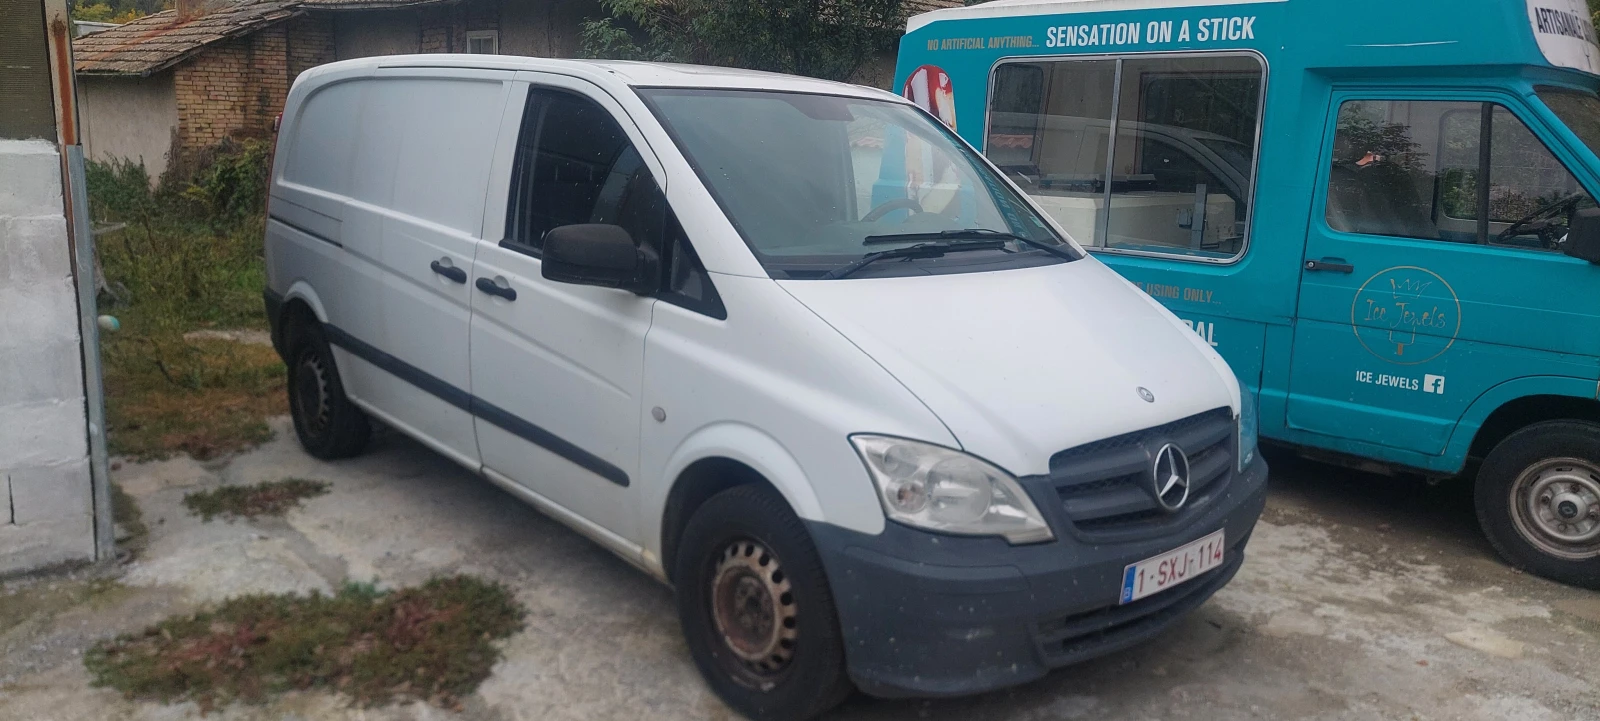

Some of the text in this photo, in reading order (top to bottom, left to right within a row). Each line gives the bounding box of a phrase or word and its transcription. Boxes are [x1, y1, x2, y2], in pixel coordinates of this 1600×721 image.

[1046, 16, 1256, 48] SENSATION ON A STICK
[927, 39, 939, 51] NO
[941, 37, 985, 50] ARTIFICIAL
[1146, 283, 1179, 299] USING
[1364, 299, 1388, 321] Ice
[1356, 370, 1373, 383] ICE
[1376, 373, 1419, 391] JEWELS
